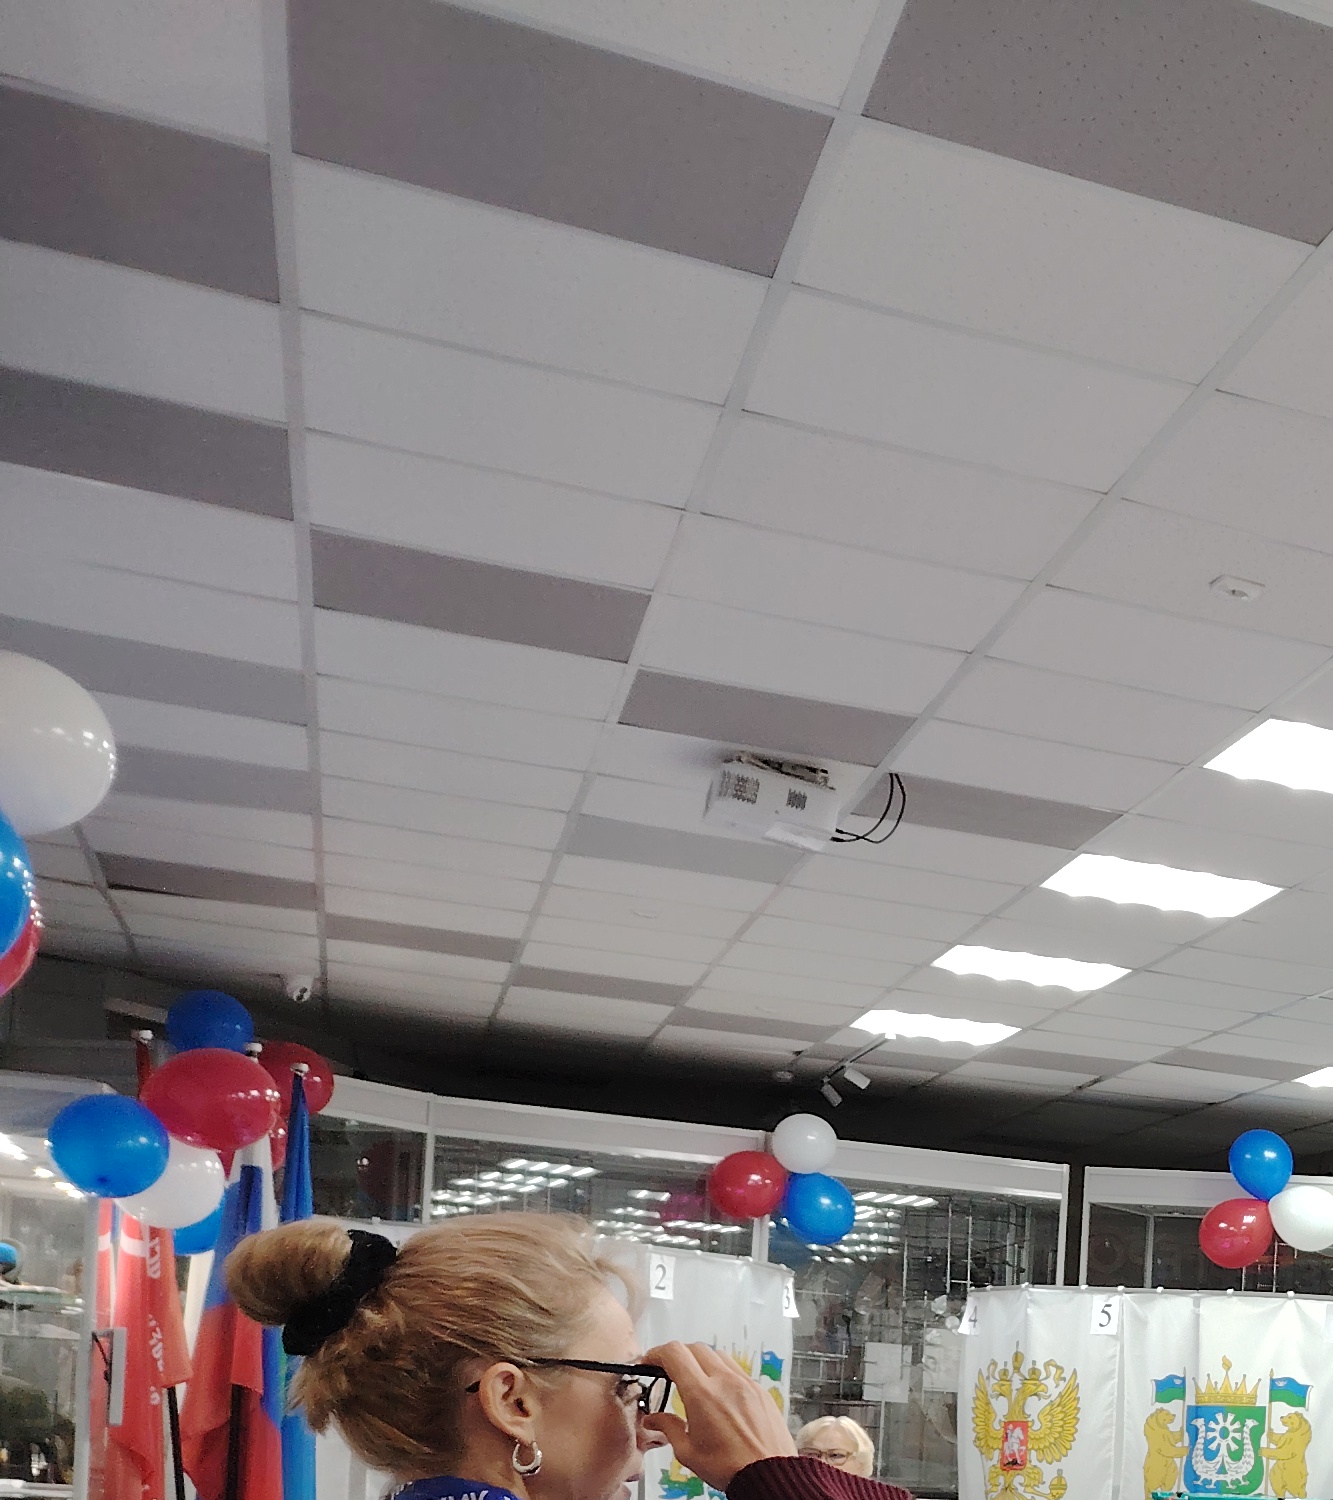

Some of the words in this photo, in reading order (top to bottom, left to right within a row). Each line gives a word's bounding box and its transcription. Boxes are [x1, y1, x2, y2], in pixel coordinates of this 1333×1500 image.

[654, 1263, 667, 1291] 2
[784, 1285, 791, 1310] 3
[968, 1305, 978, 1329] 4
[1098, 1303, 1113, 1328] 5
